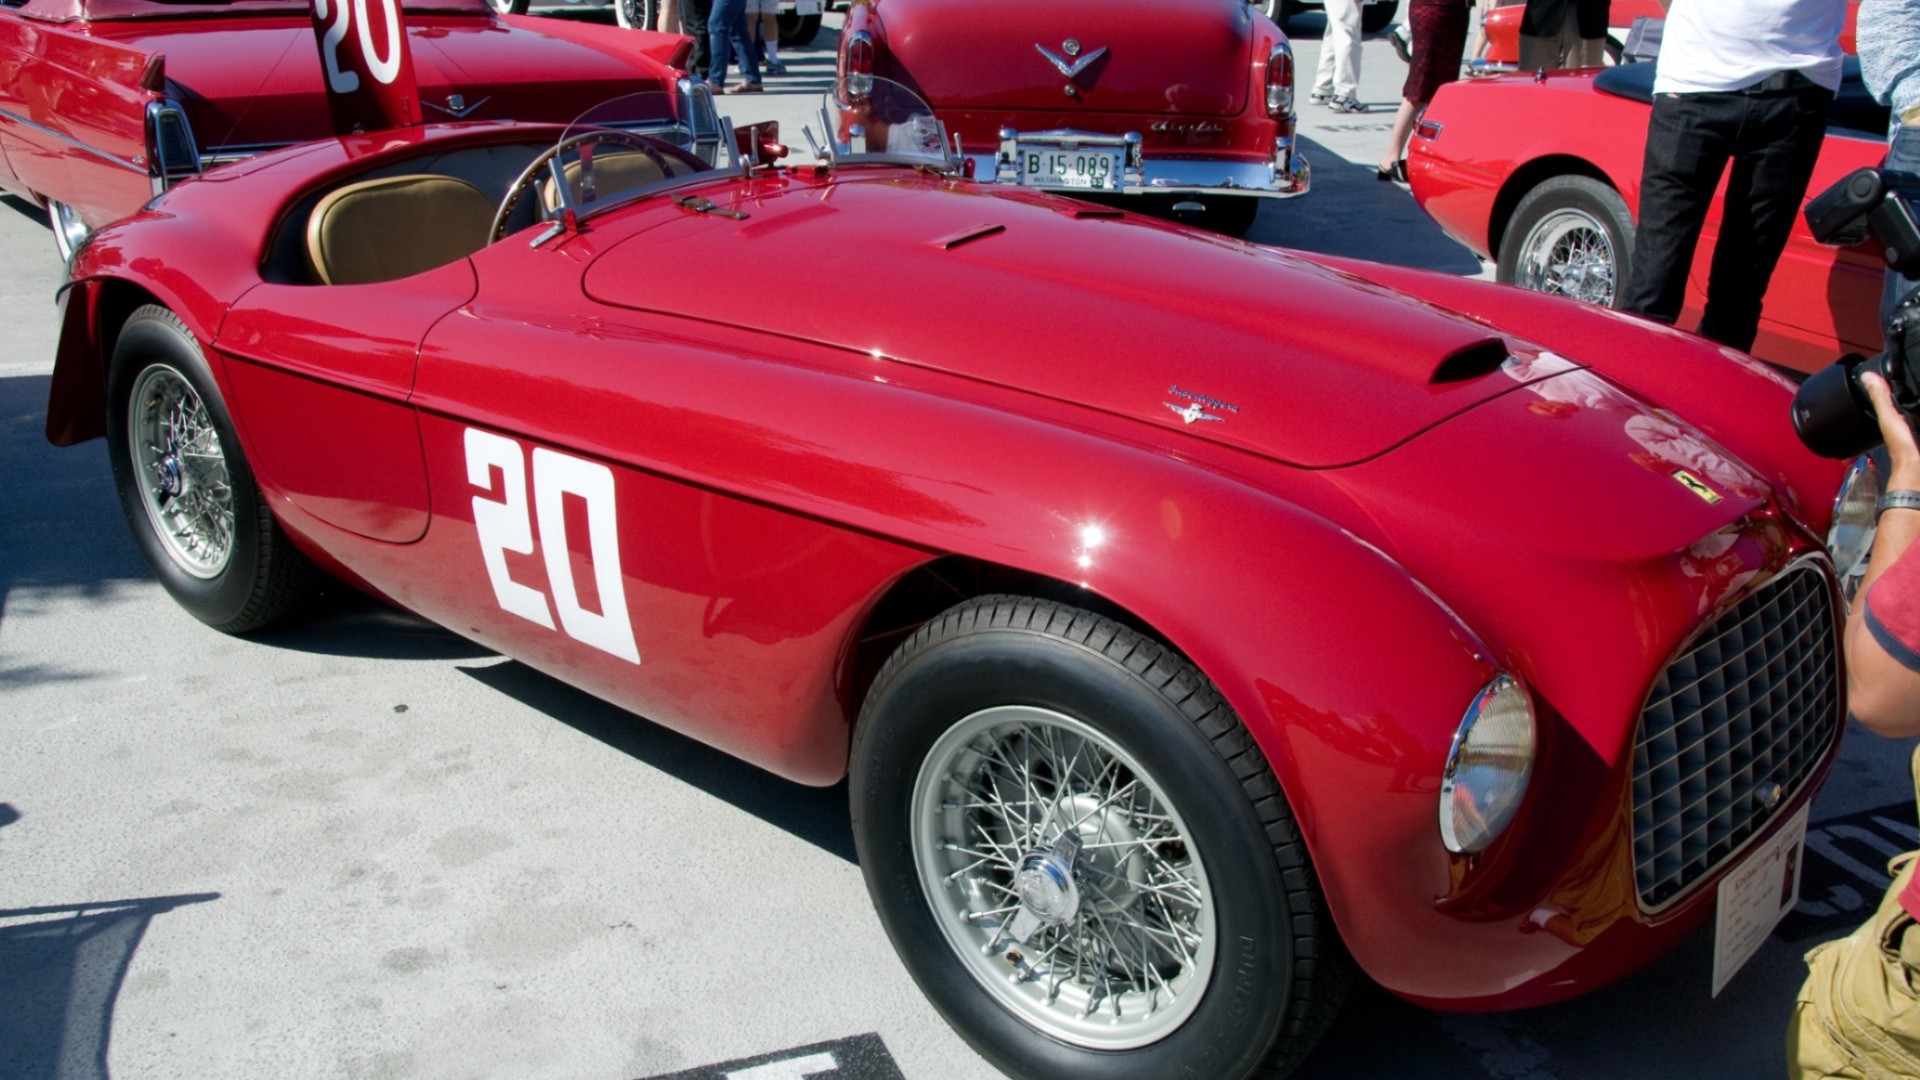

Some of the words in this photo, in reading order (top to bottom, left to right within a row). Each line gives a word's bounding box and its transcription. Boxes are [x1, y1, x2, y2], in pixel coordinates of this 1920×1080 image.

[314, 0, 401, 94] 20
[1033, 176, 1088, 185] WASHINGTON
[463, 426, 641, 666] 20
